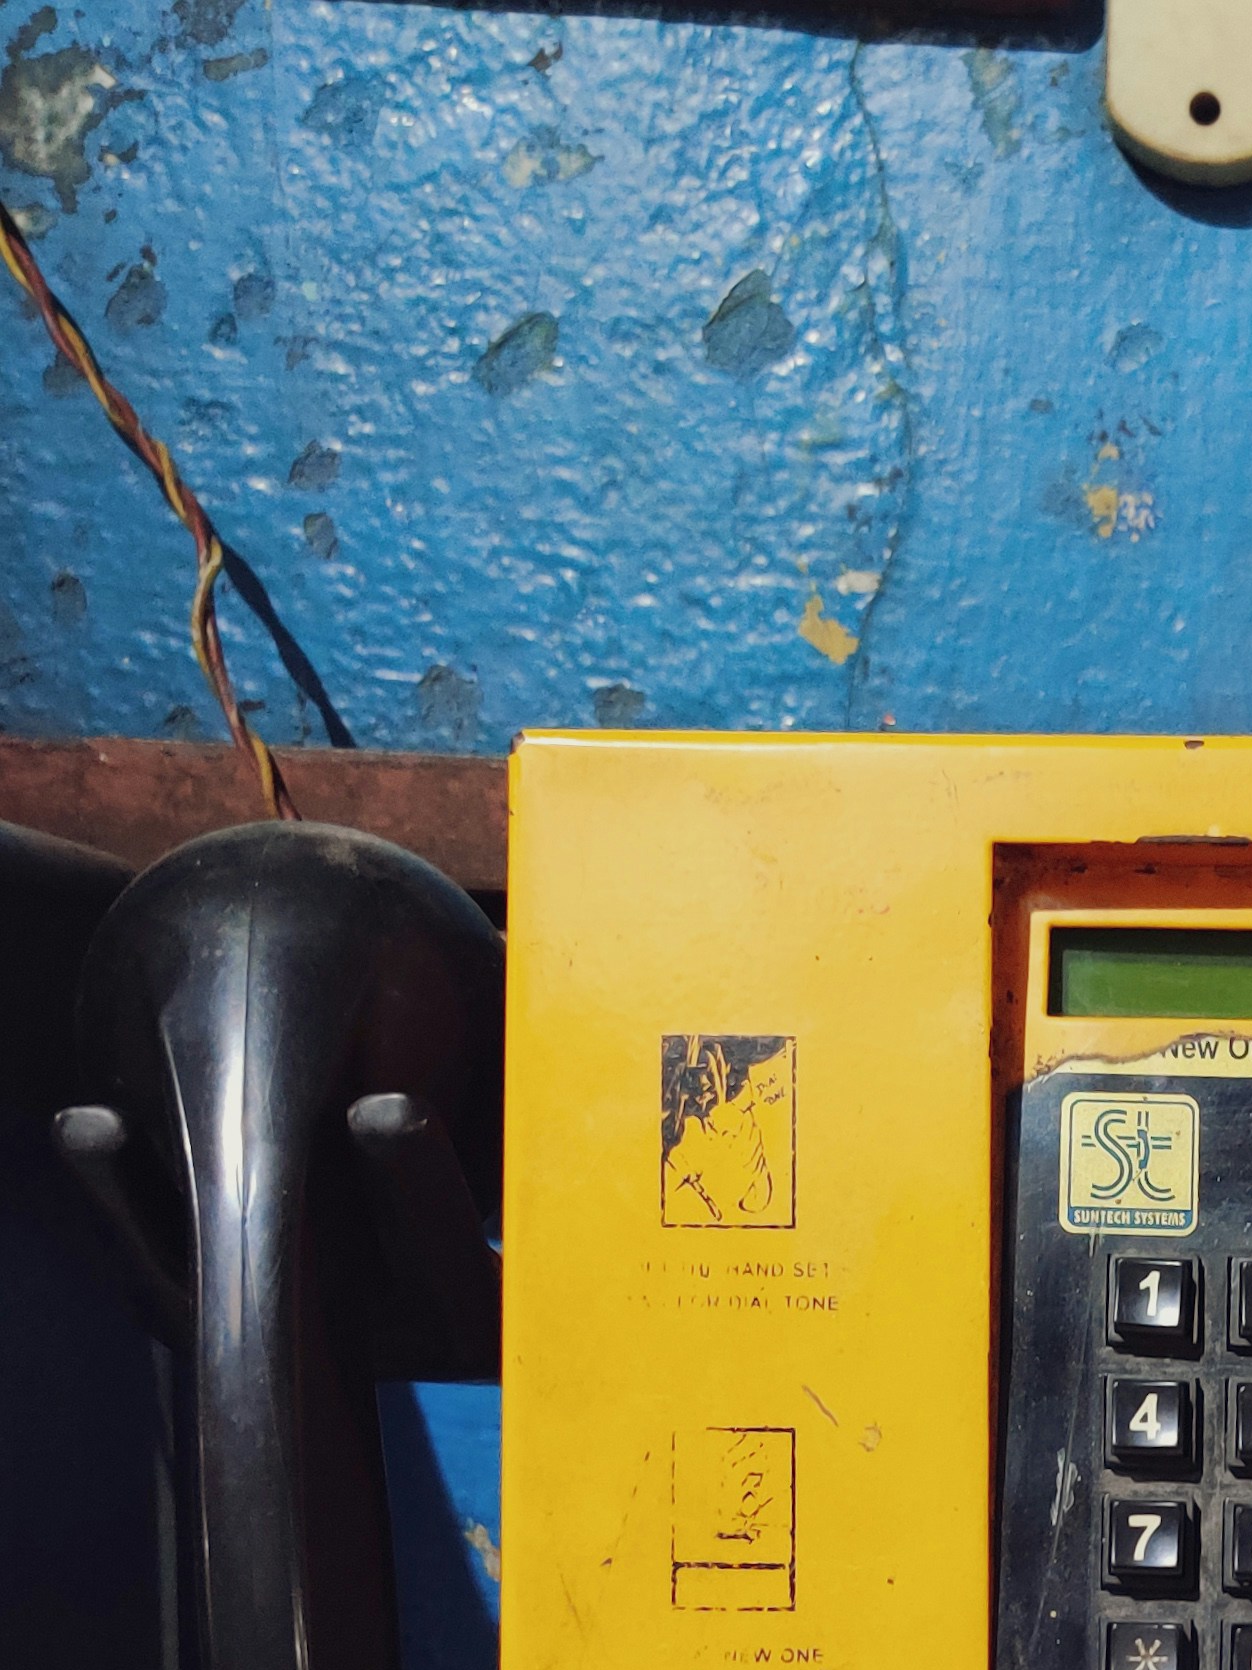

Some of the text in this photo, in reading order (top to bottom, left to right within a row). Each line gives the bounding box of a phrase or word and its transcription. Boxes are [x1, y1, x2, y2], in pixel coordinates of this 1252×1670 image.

[1073, 1209, 1186, 1226] SUNTECH SYSTEMS
[784, 1295, 839, 1311] TONE
[1139, 1270, 1161, 1317] 1
[1129, 1393, 1161, 1440] 4
[1128, 1514, 1161, 1561] 7
[780, 1648, 824, 1663] ONE
